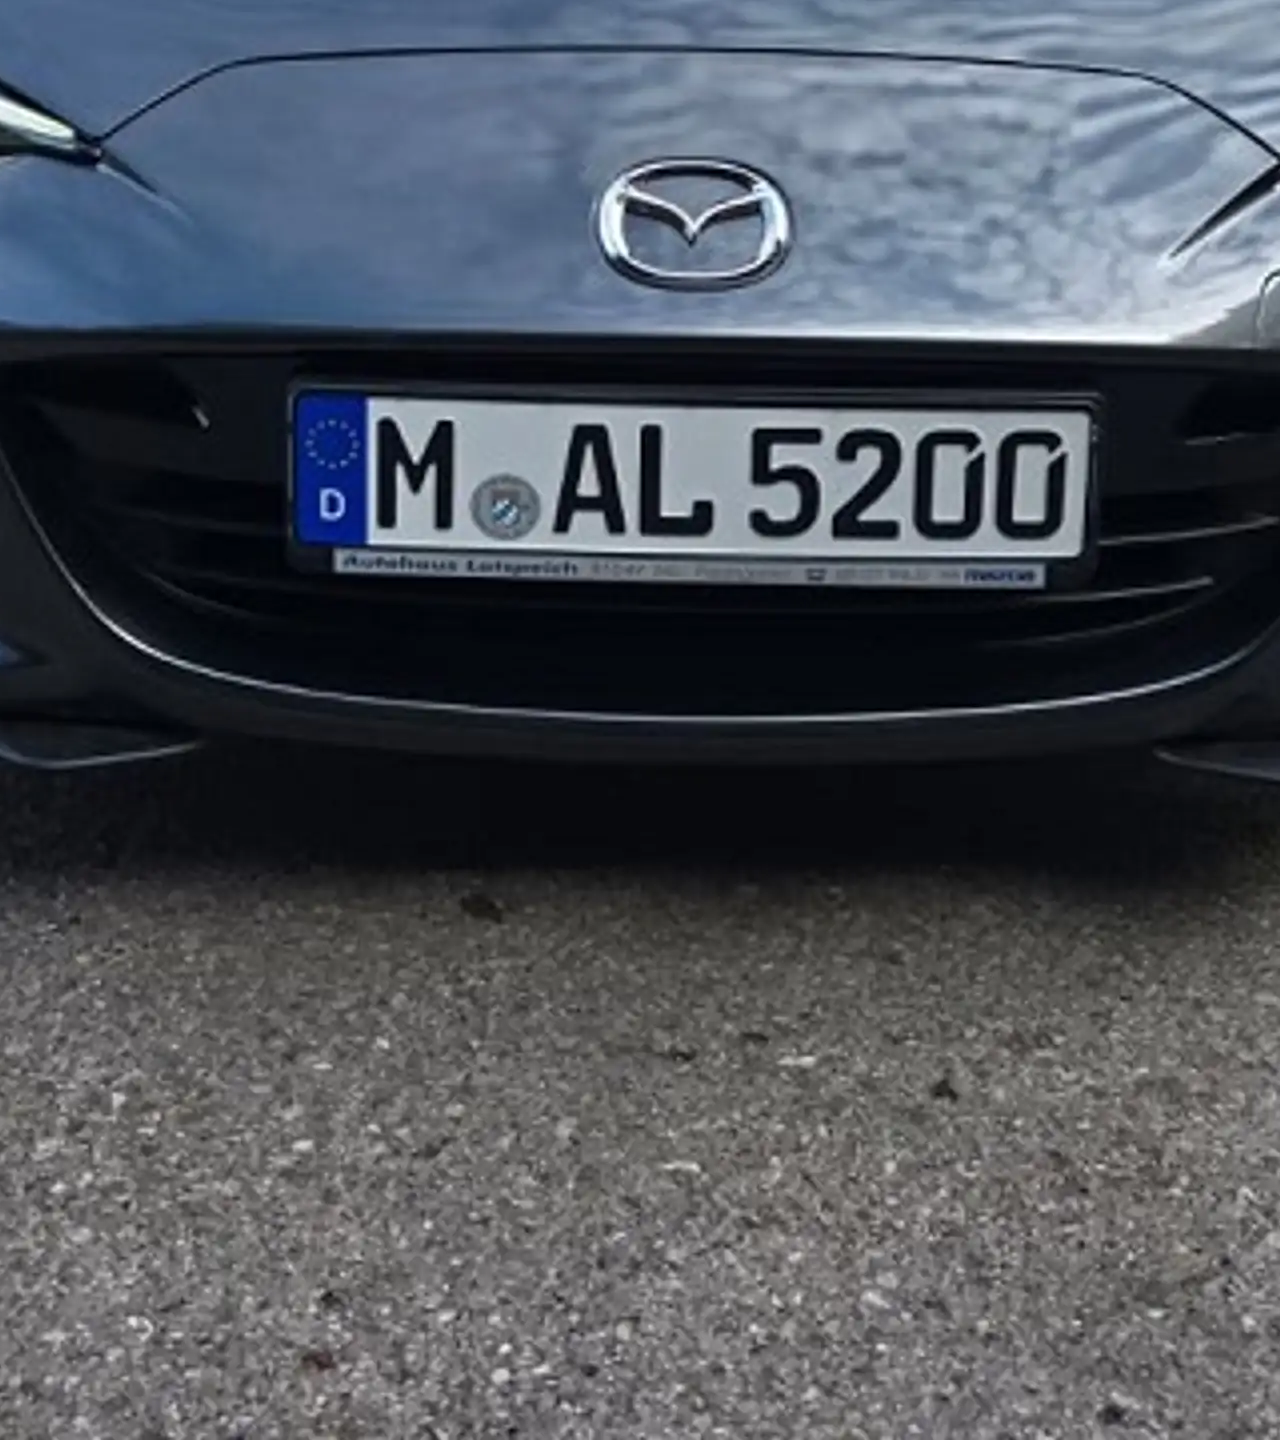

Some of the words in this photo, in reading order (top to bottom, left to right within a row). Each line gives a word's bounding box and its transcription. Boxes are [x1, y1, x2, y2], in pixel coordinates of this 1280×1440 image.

[375, 418, 455, 530] M
[552, 423, 715, 537] AL
[748, 426, 1068, 541] 5200
[320, 489, 346, 520] D
[342, 554, 458, 572] Autohaus
[467, 558, 579, 577] Lotspeich
